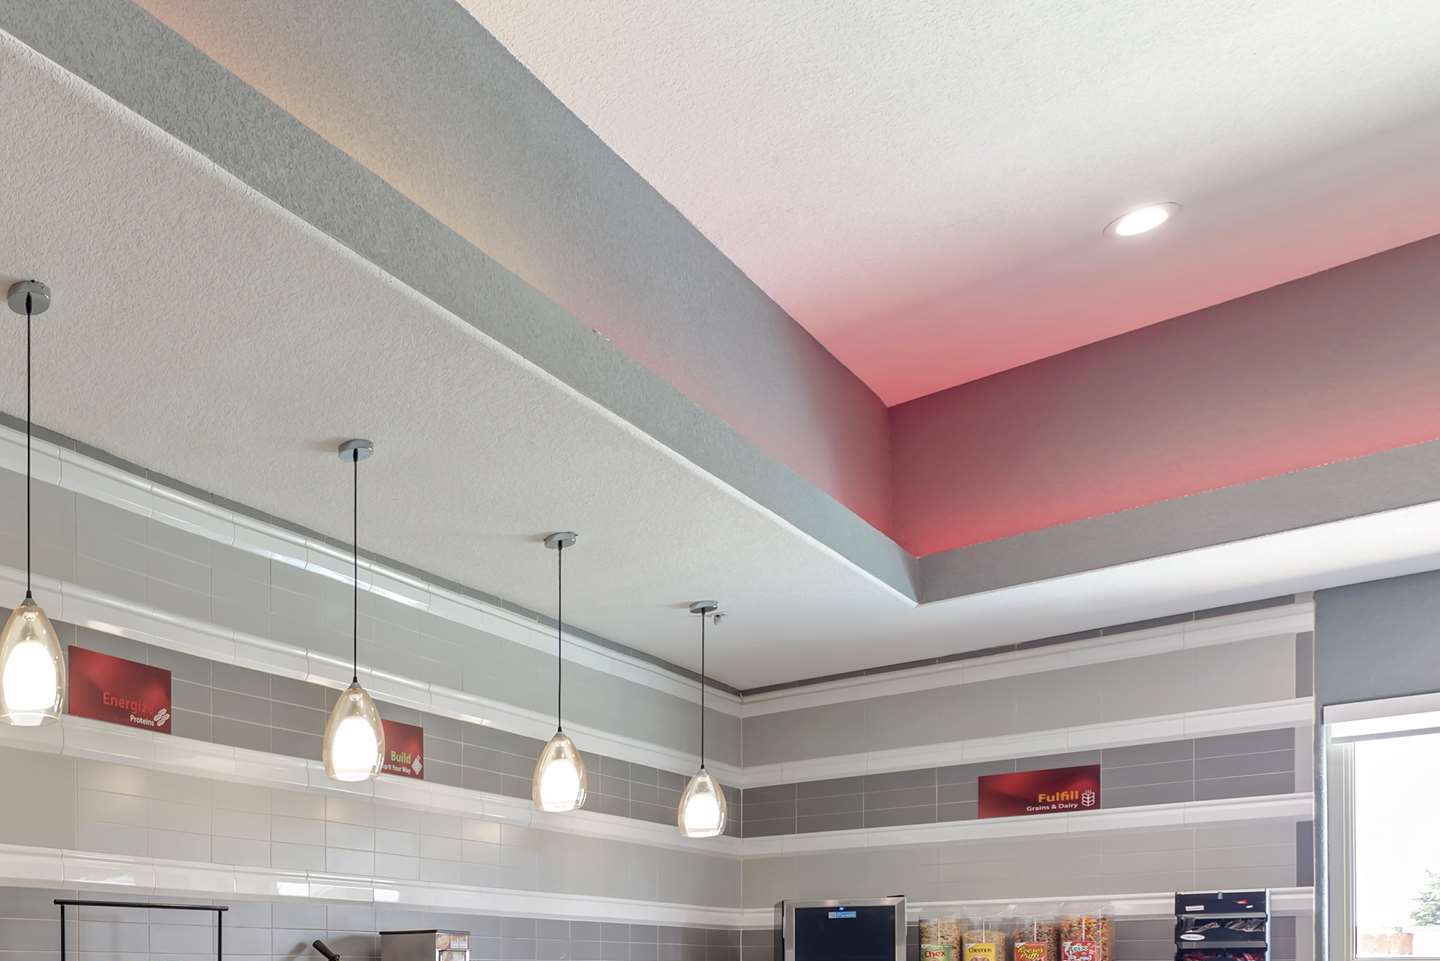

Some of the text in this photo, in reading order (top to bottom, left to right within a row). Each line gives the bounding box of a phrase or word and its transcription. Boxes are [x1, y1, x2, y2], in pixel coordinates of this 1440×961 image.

[103, 692, 154, 714] Energi
[130, 714, 154, 726] Proteins
[391, 750, 411, 764] Build
[1038, 790, 1079, 803] Fulfill
[1026, 804, 1051, 812] Grains
[1058, 802, 1079, 810] Dairy
